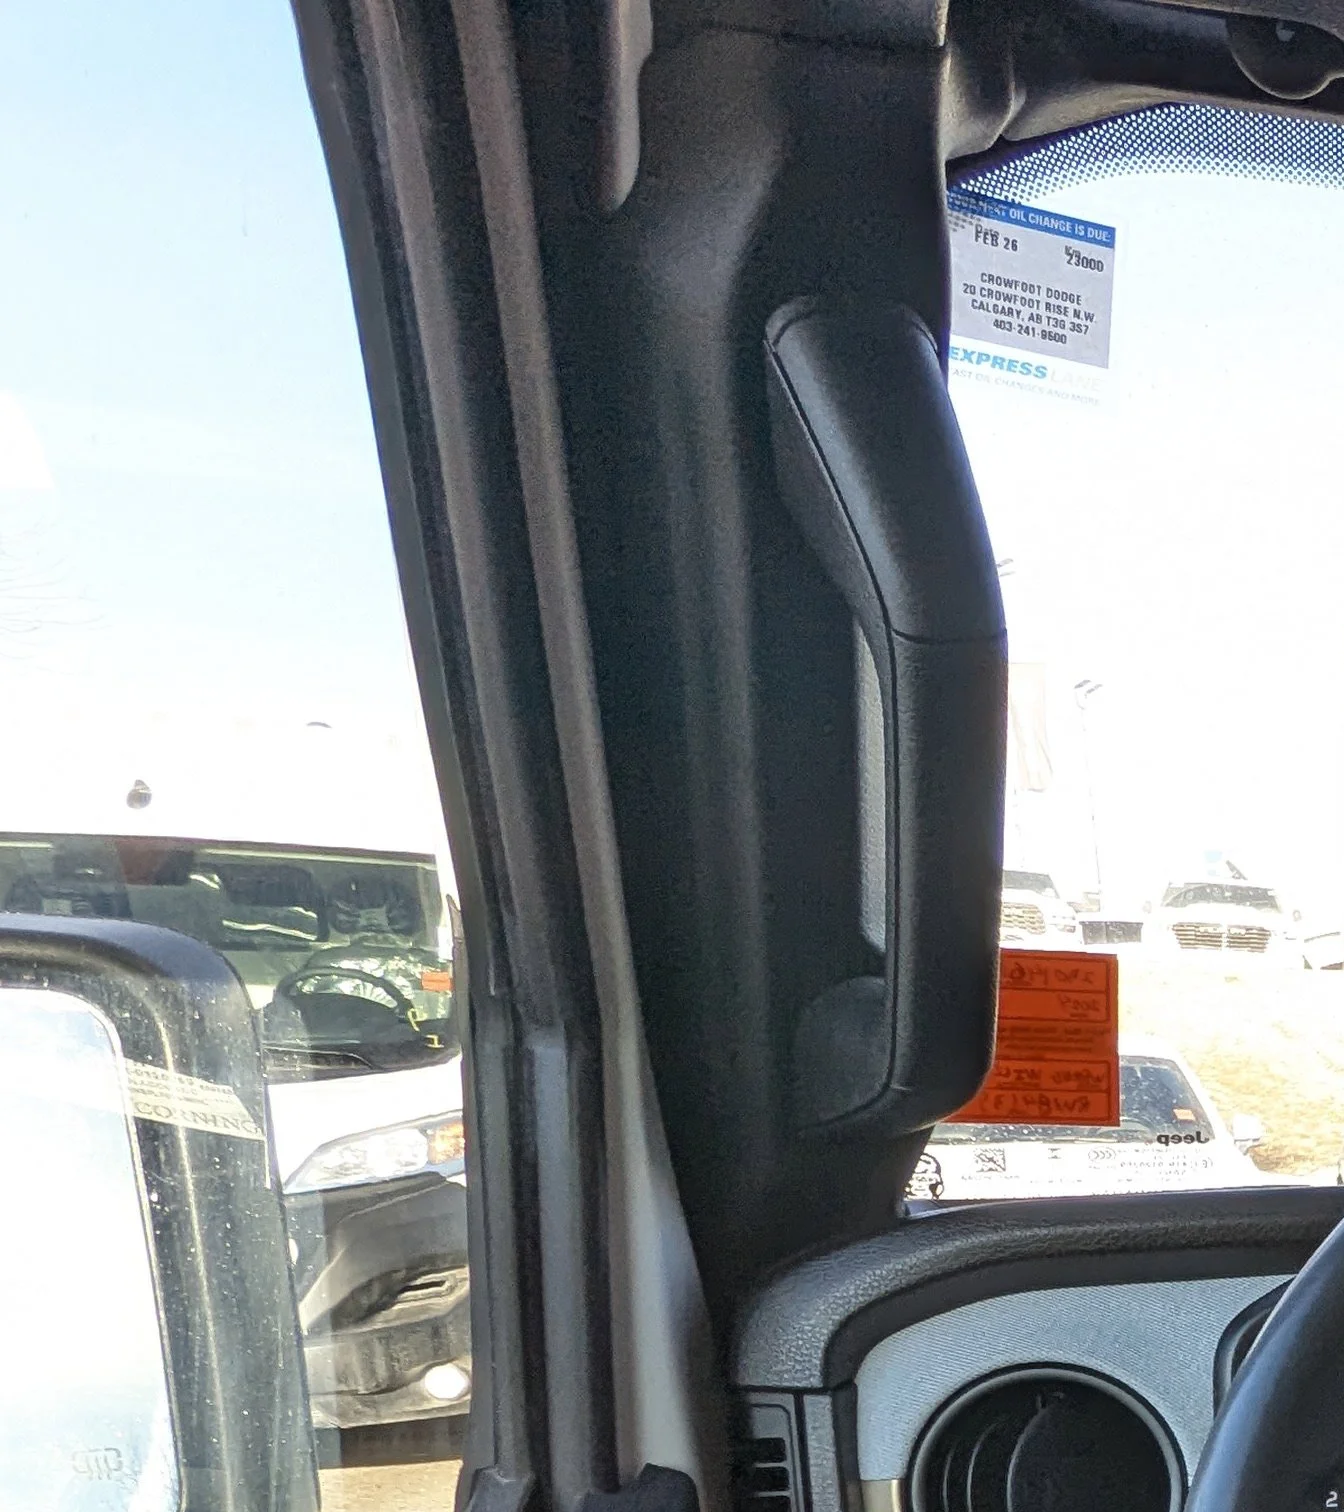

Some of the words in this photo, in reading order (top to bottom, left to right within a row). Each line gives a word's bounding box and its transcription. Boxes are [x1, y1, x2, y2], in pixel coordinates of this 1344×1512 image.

[1009, 207, 1027, 222] OIL
[1028, 213, 1073, 233] CHANGE
[1074, 224, 1086, 237] IS
[975, 230, 999, 248] FEB
[1003, 236, 1018, 252] 26
[1065, 252, 1105, 273] 23000
[963, 283, 977, 296] 20
[979, 286, 1042, 310] CROWFOOT
[1045, 300, 1069, 316] RISE
[1072, 309, 1096, 323] N.W.
[980, 273, 1042, 296] CROWFOOT
[1046, 287, 1082, 306] DODGE
[971, 299, 1025, 323] CALGARY,
[1027, 311, 1043, 325] AB
[1046, 315, 1066, 332] T3G
[1069, 320, 1090, 336] 3S7
[949, 346, 1048, 380] EXPRESS
[1325, 1490, 1339, 1508] 2
